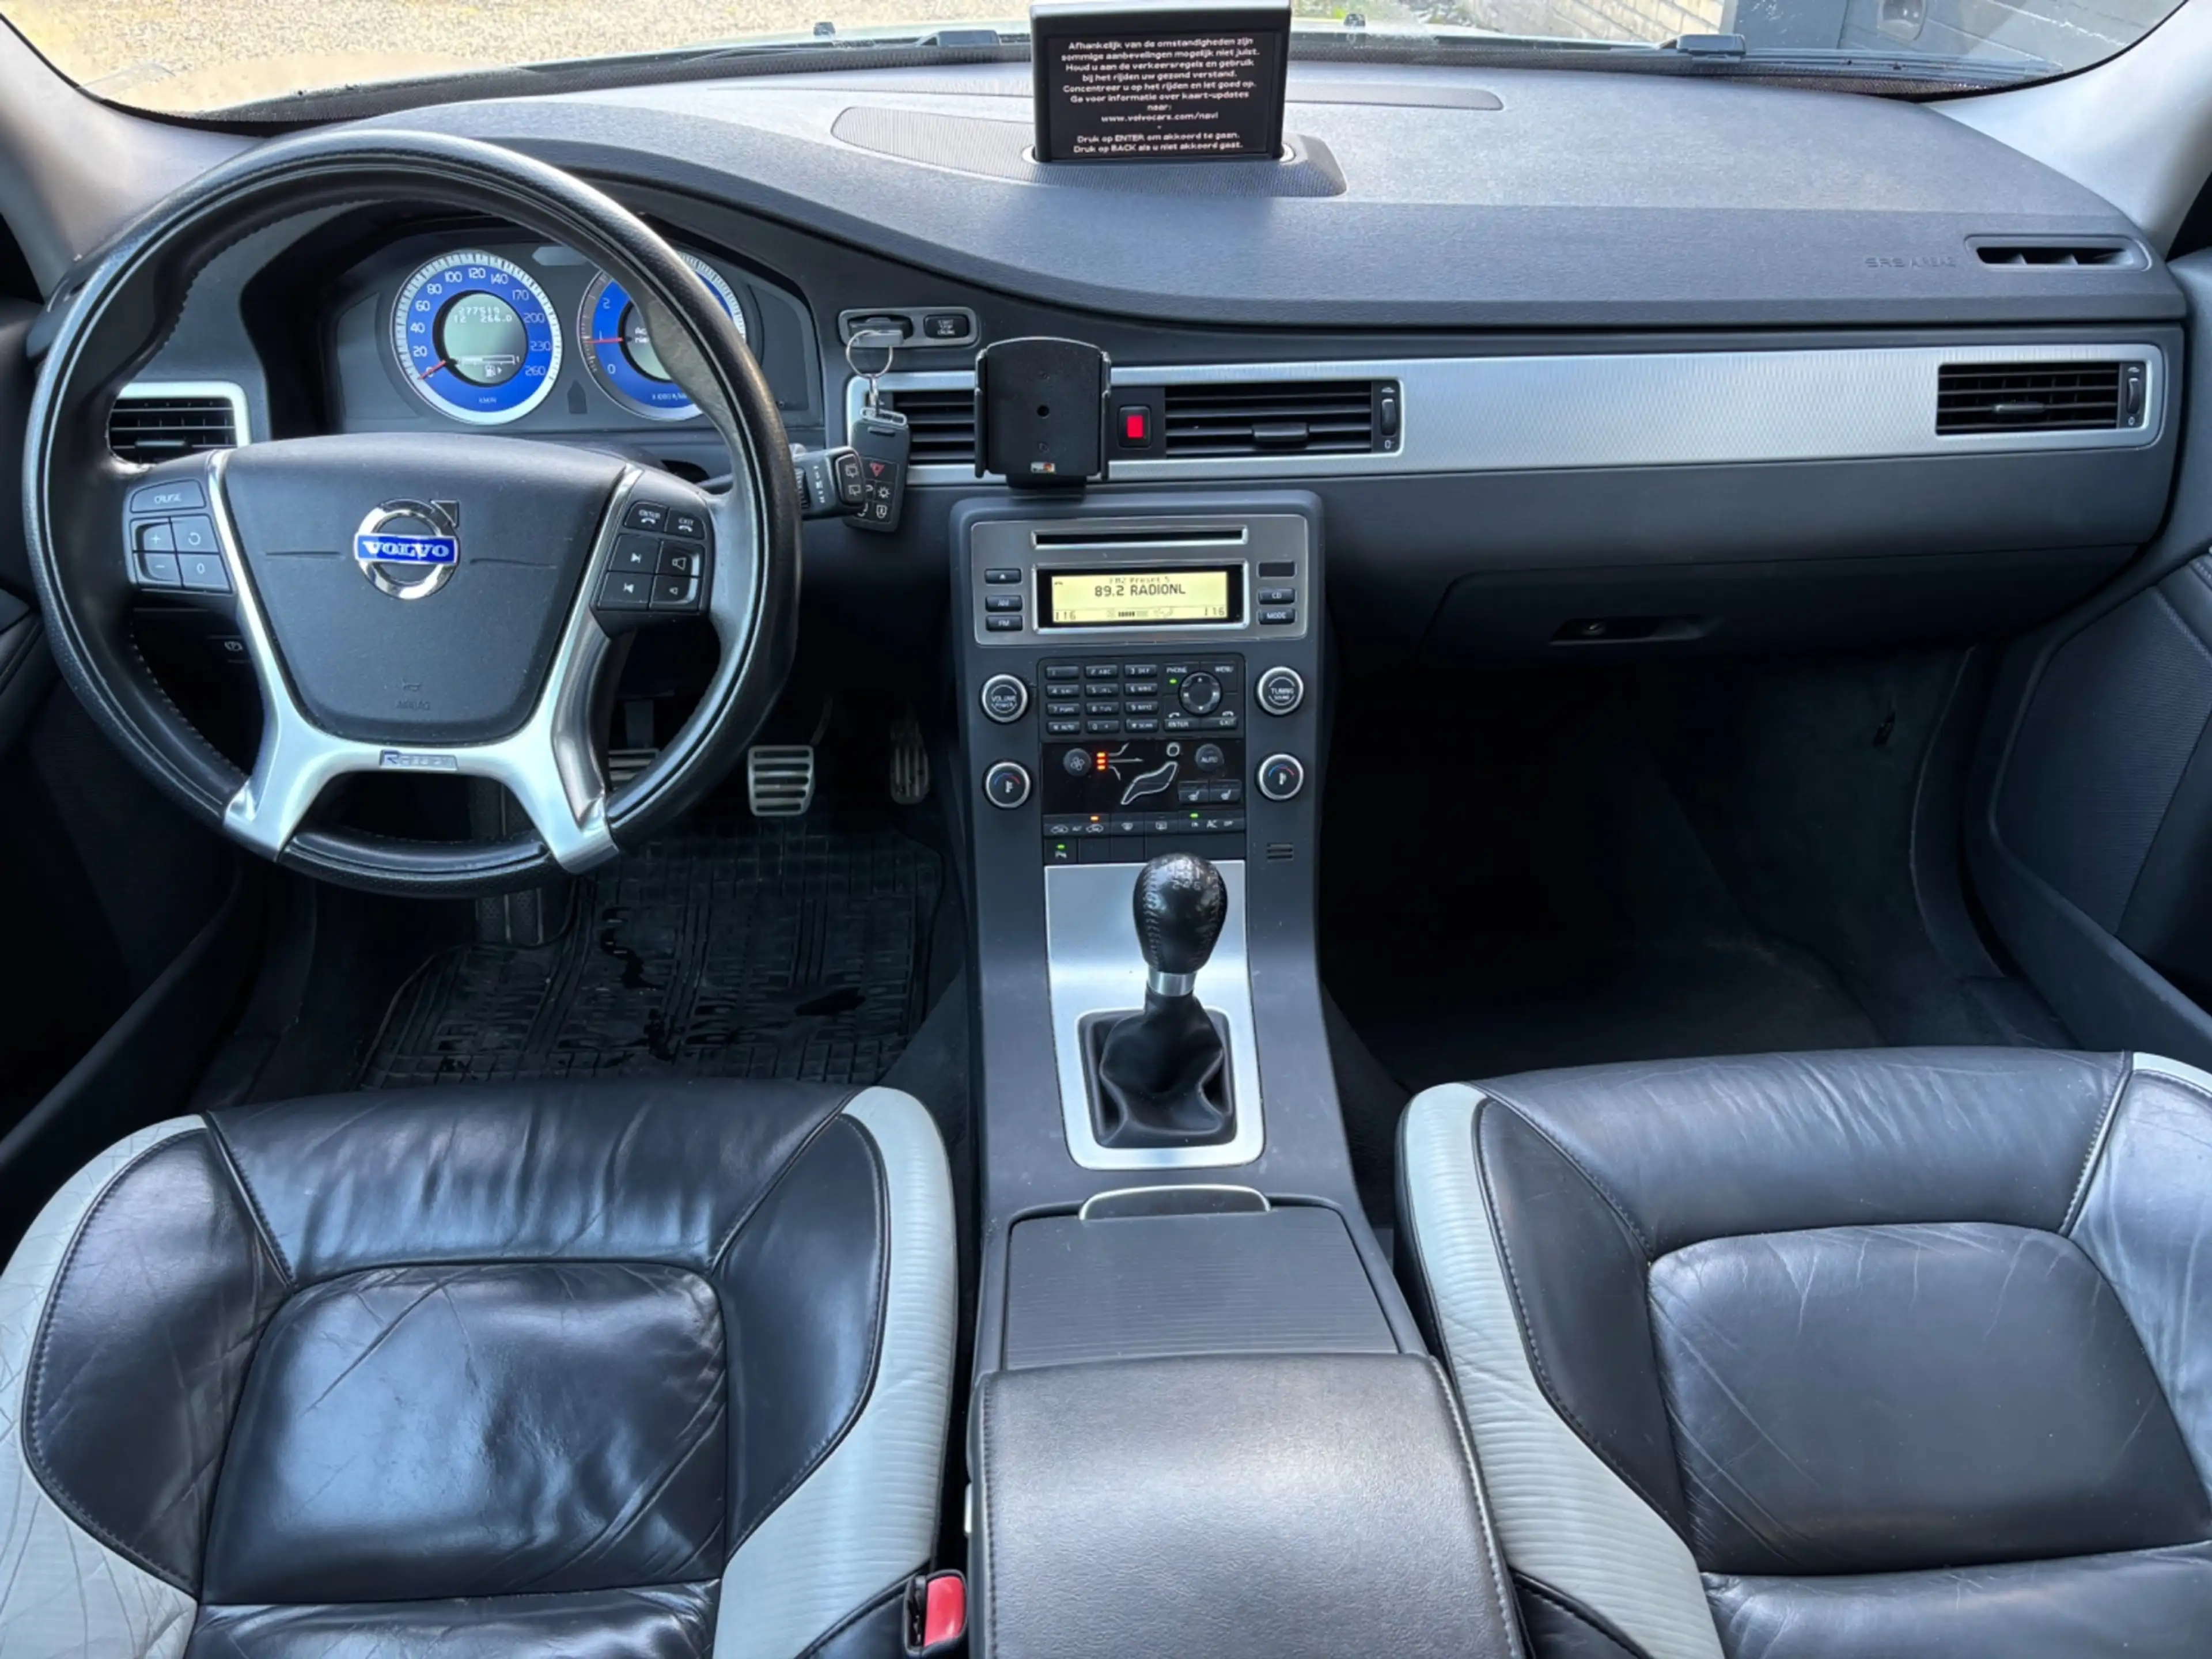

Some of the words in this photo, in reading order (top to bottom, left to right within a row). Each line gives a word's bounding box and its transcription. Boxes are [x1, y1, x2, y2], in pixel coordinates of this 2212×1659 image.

[1069, 41, 1122, 50] Afhankelijk
[1157, 39, 1235, 47] omstandigheden
[1237, 37, 1253, 46] zijn
[1061, 52, 1104, 62] sommige
[1105, 51, 1172, 60] aanbevelingen
[1174, 49, 1214, 59] mogelijk
[1215, 48, 1234, 56] niet
[1066, 63, 1090, 71] Houd
[1132, 60, 1203, 70] verkeersregels
[1219, 59, 1254, 69] gebruik
[1082, 74, 1094, 84] bij
[1095, 74, 1111, 82] het
[1113, 73, 1139, 82] rijden
[1157, 71, 1191, 81] gezond
[1063, 84, 1121, 92] Concentreer
[1161, 82, 1188, 91] rijden
[1203, 81, 1216, 89] let
[1218, 80, 1241, 89] goed
[1070, 95, 1084, 103] Ga
[1107, 93, 1157, 102] informatie
[1077, 135, 1099, 143] Druk
[1115, 134, 1145, 142] ENTER
[1163, 132, 1202, 141] akkoord
[1073, 145, 1096, 153] Druk
[1111, 144, 1137, 152] BACK
[1180, 142, 1218, 150] akkoord
[444, 271, 463, 282] 100
[468, 267, 486, 279] 120
[491, 274, 509, 285] 140
[427, 283, 442, 295] 80
[512, 289, 529, 301] 170
[415, 300, 431, 312] 60
[603, 297, 611, 309] 2
[523, 313, 545, 324] 200
[410, 322, 425, 334] 40
[412, 346, 427, 357] 20
[530, 341, 551, 351] 230
[525, 365, 546, 376] 260
[607, 364, 616, 374] 0
[362, 540, 449, 559] VOLVO
[1094, 585, 1124, 597] 89.2
[1130, 584, 1186, 596] RADIONL
[1206, 820, 1218, 828] AC
